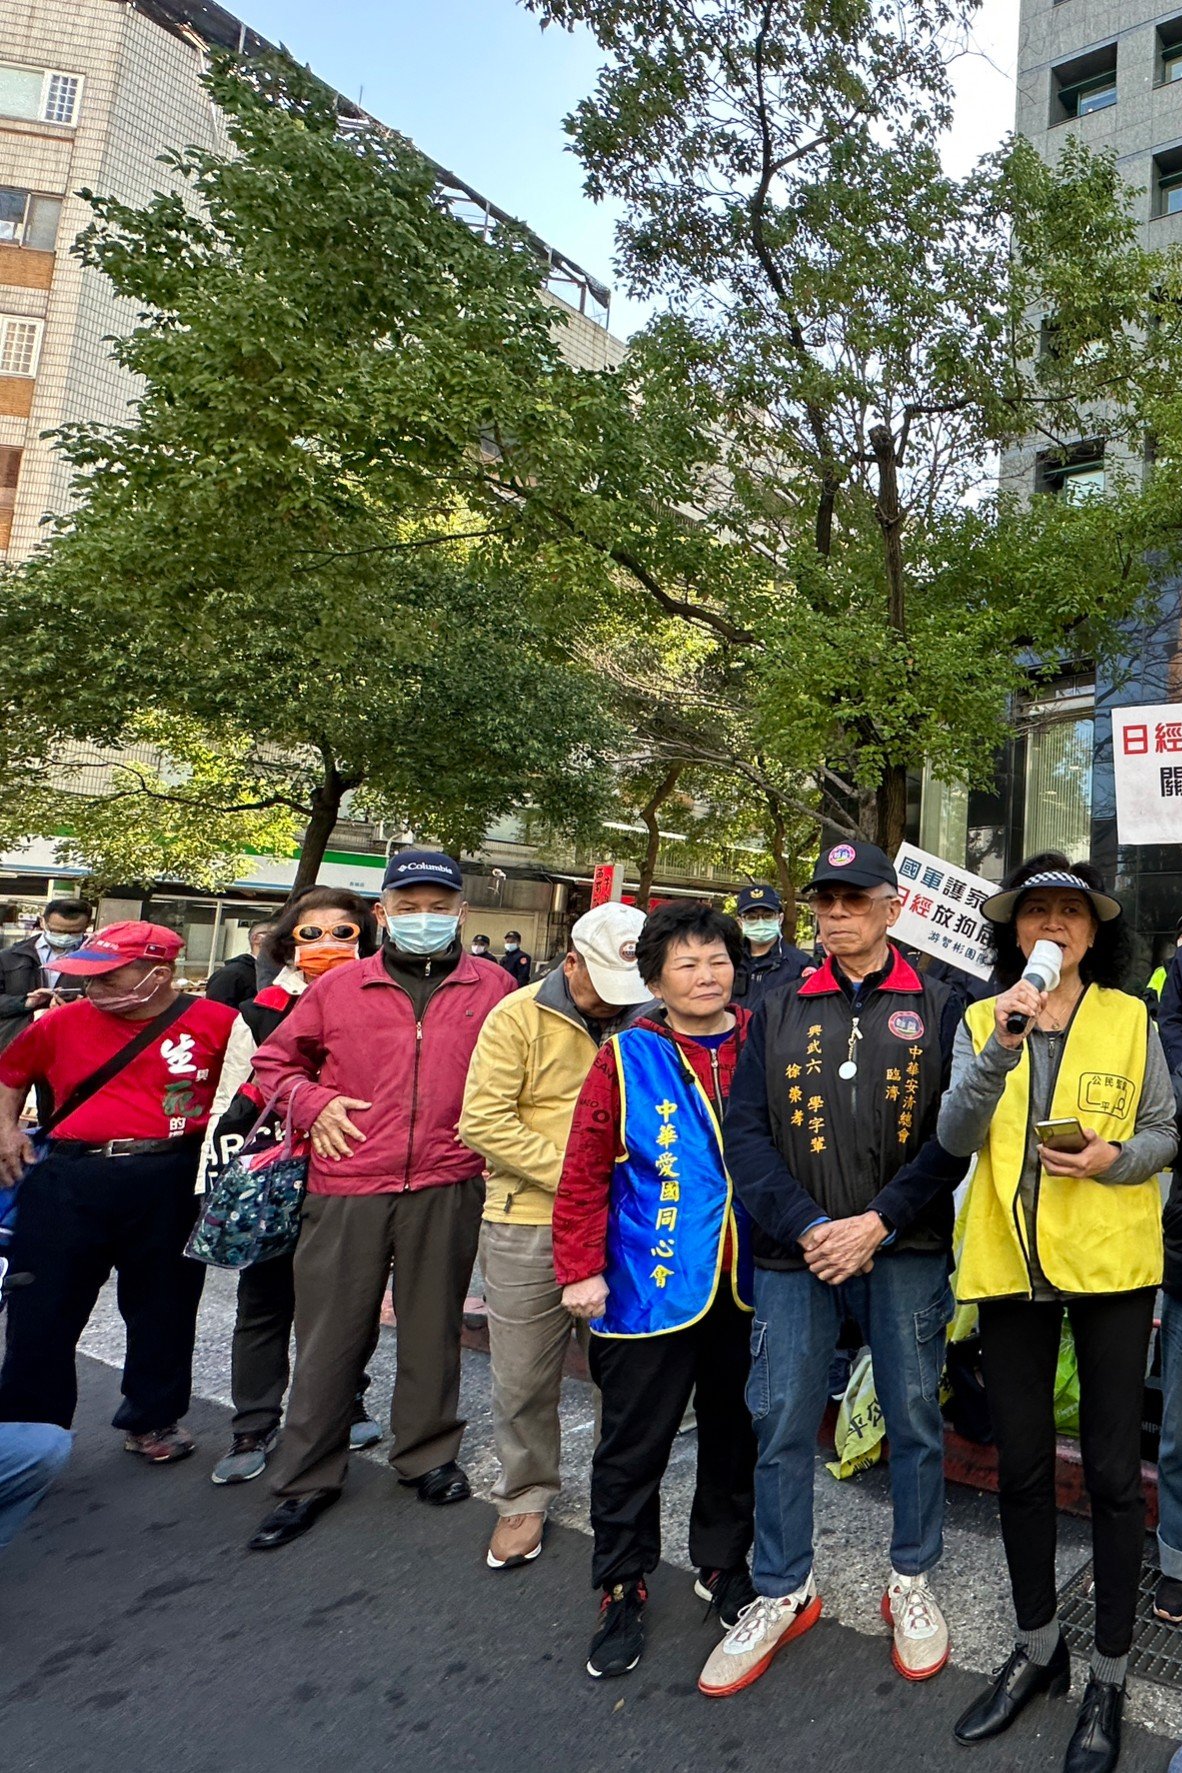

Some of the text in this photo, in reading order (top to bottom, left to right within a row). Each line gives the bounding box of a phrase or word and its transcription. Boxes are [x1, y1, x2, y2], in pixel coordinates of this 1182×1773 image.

[407, 861, 453, 875] Columbia
[885, 1067, 901, 1101] 臨濟
[897, 1044, 923, 1144] 中華安清總會
[649, 1098, 680, 1289] 中華愛國同心會
